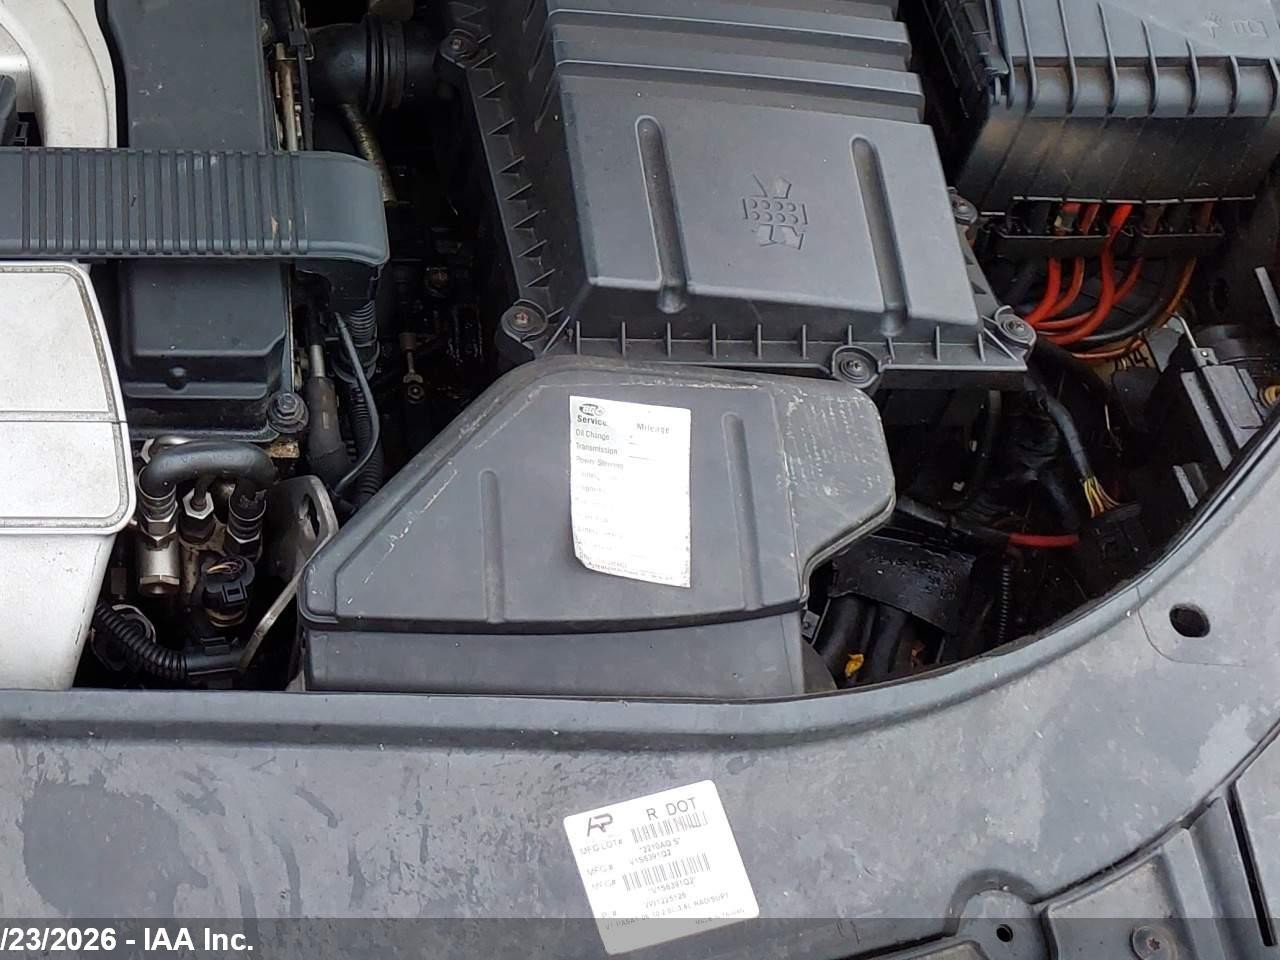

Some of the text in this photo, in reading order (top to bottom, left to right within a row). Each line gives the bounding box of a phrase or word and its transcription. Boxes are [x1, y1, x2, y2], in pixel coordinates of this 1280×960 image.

[585, 429, 610, 442] Change
[575, 441, 618, 456] Transmission
[646, 797, 698, 821] R DOT
